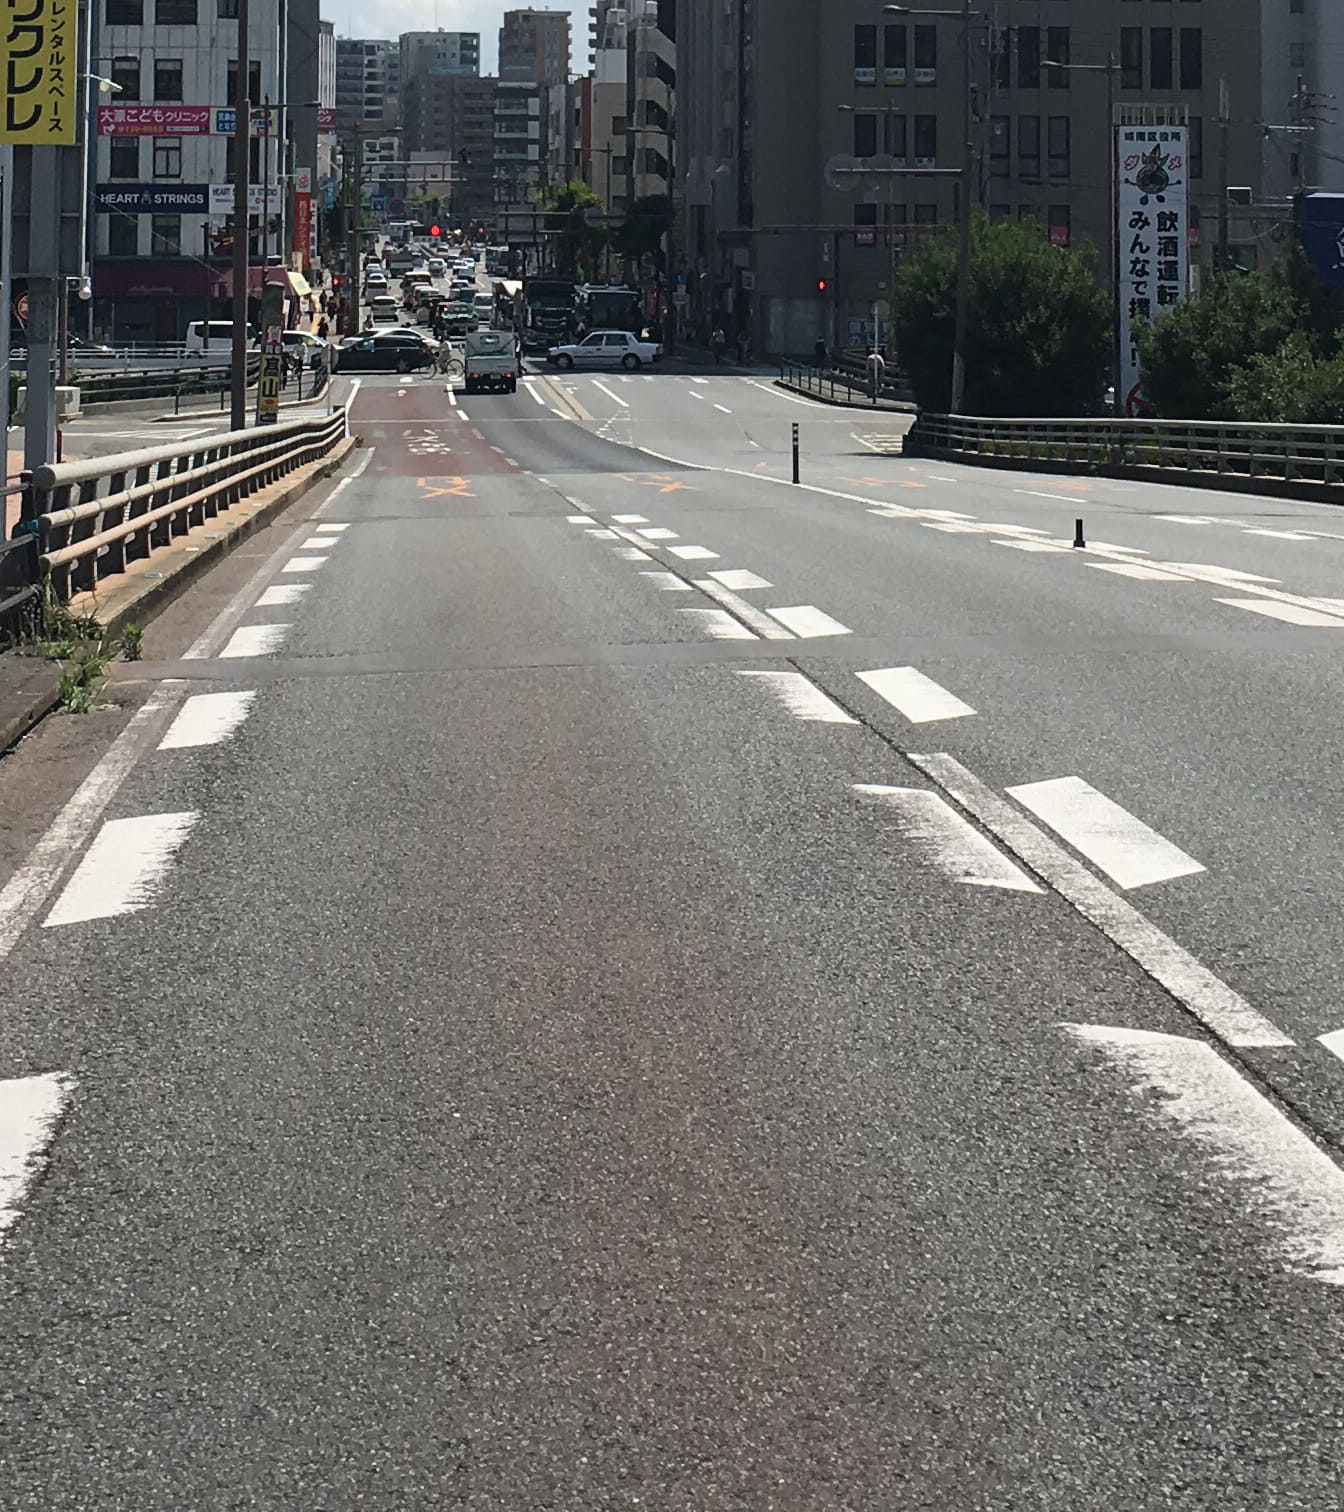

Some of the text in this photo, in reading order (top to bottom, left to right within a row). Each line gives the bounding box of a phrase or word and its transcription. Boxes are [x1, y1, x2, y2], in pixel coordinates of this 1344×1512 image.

[100, 193, 204, 204] HEART STRINGS
[1156, 210, 1179, 306] 飲酒運転
